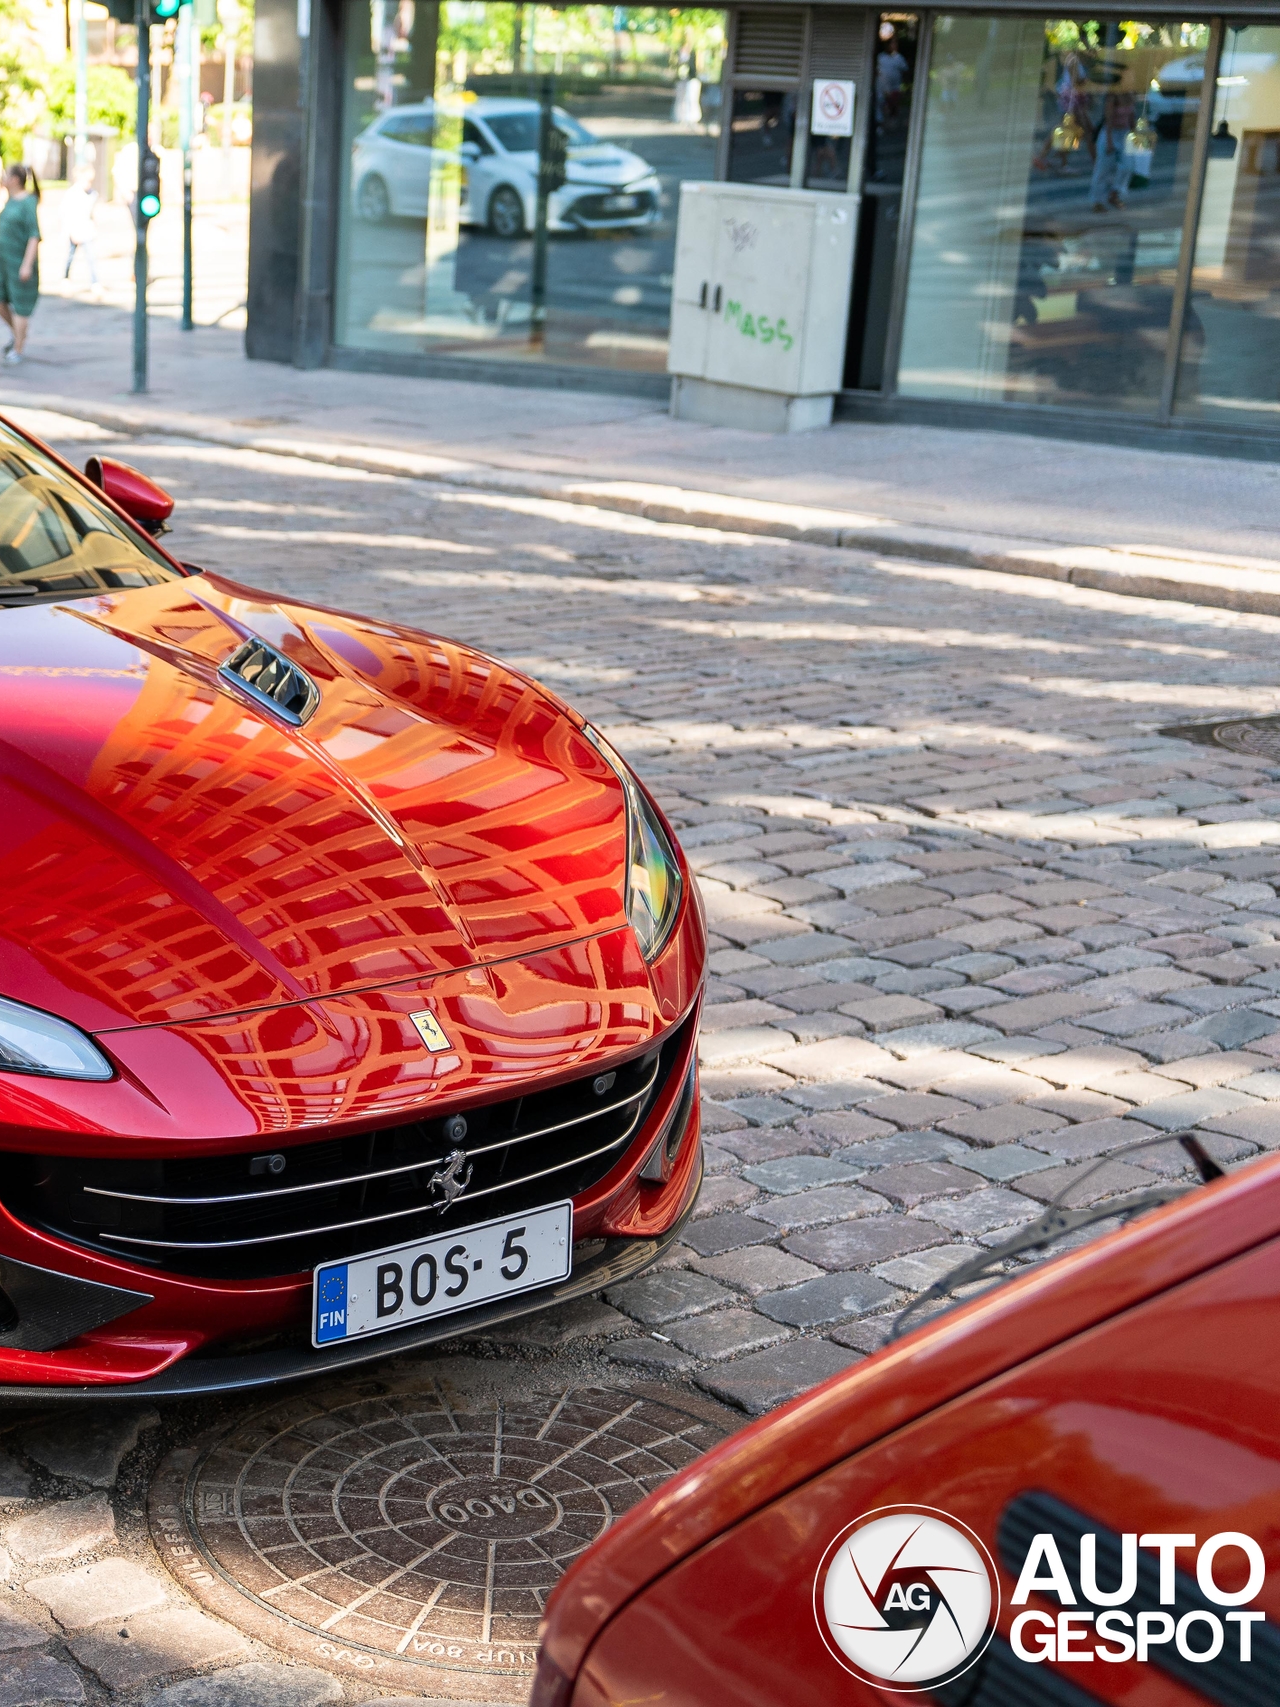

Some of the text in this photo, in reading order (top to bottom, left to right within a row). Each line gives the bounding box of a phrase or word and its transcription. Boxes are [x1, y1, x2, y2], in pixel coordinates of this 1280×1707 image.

[724, 299, 794, 351] MASS
[319, 1308, 345, 1330] FIN
[439, 1487, 551, 1522] D400
[314, 1641, 376, 1669] GJS
